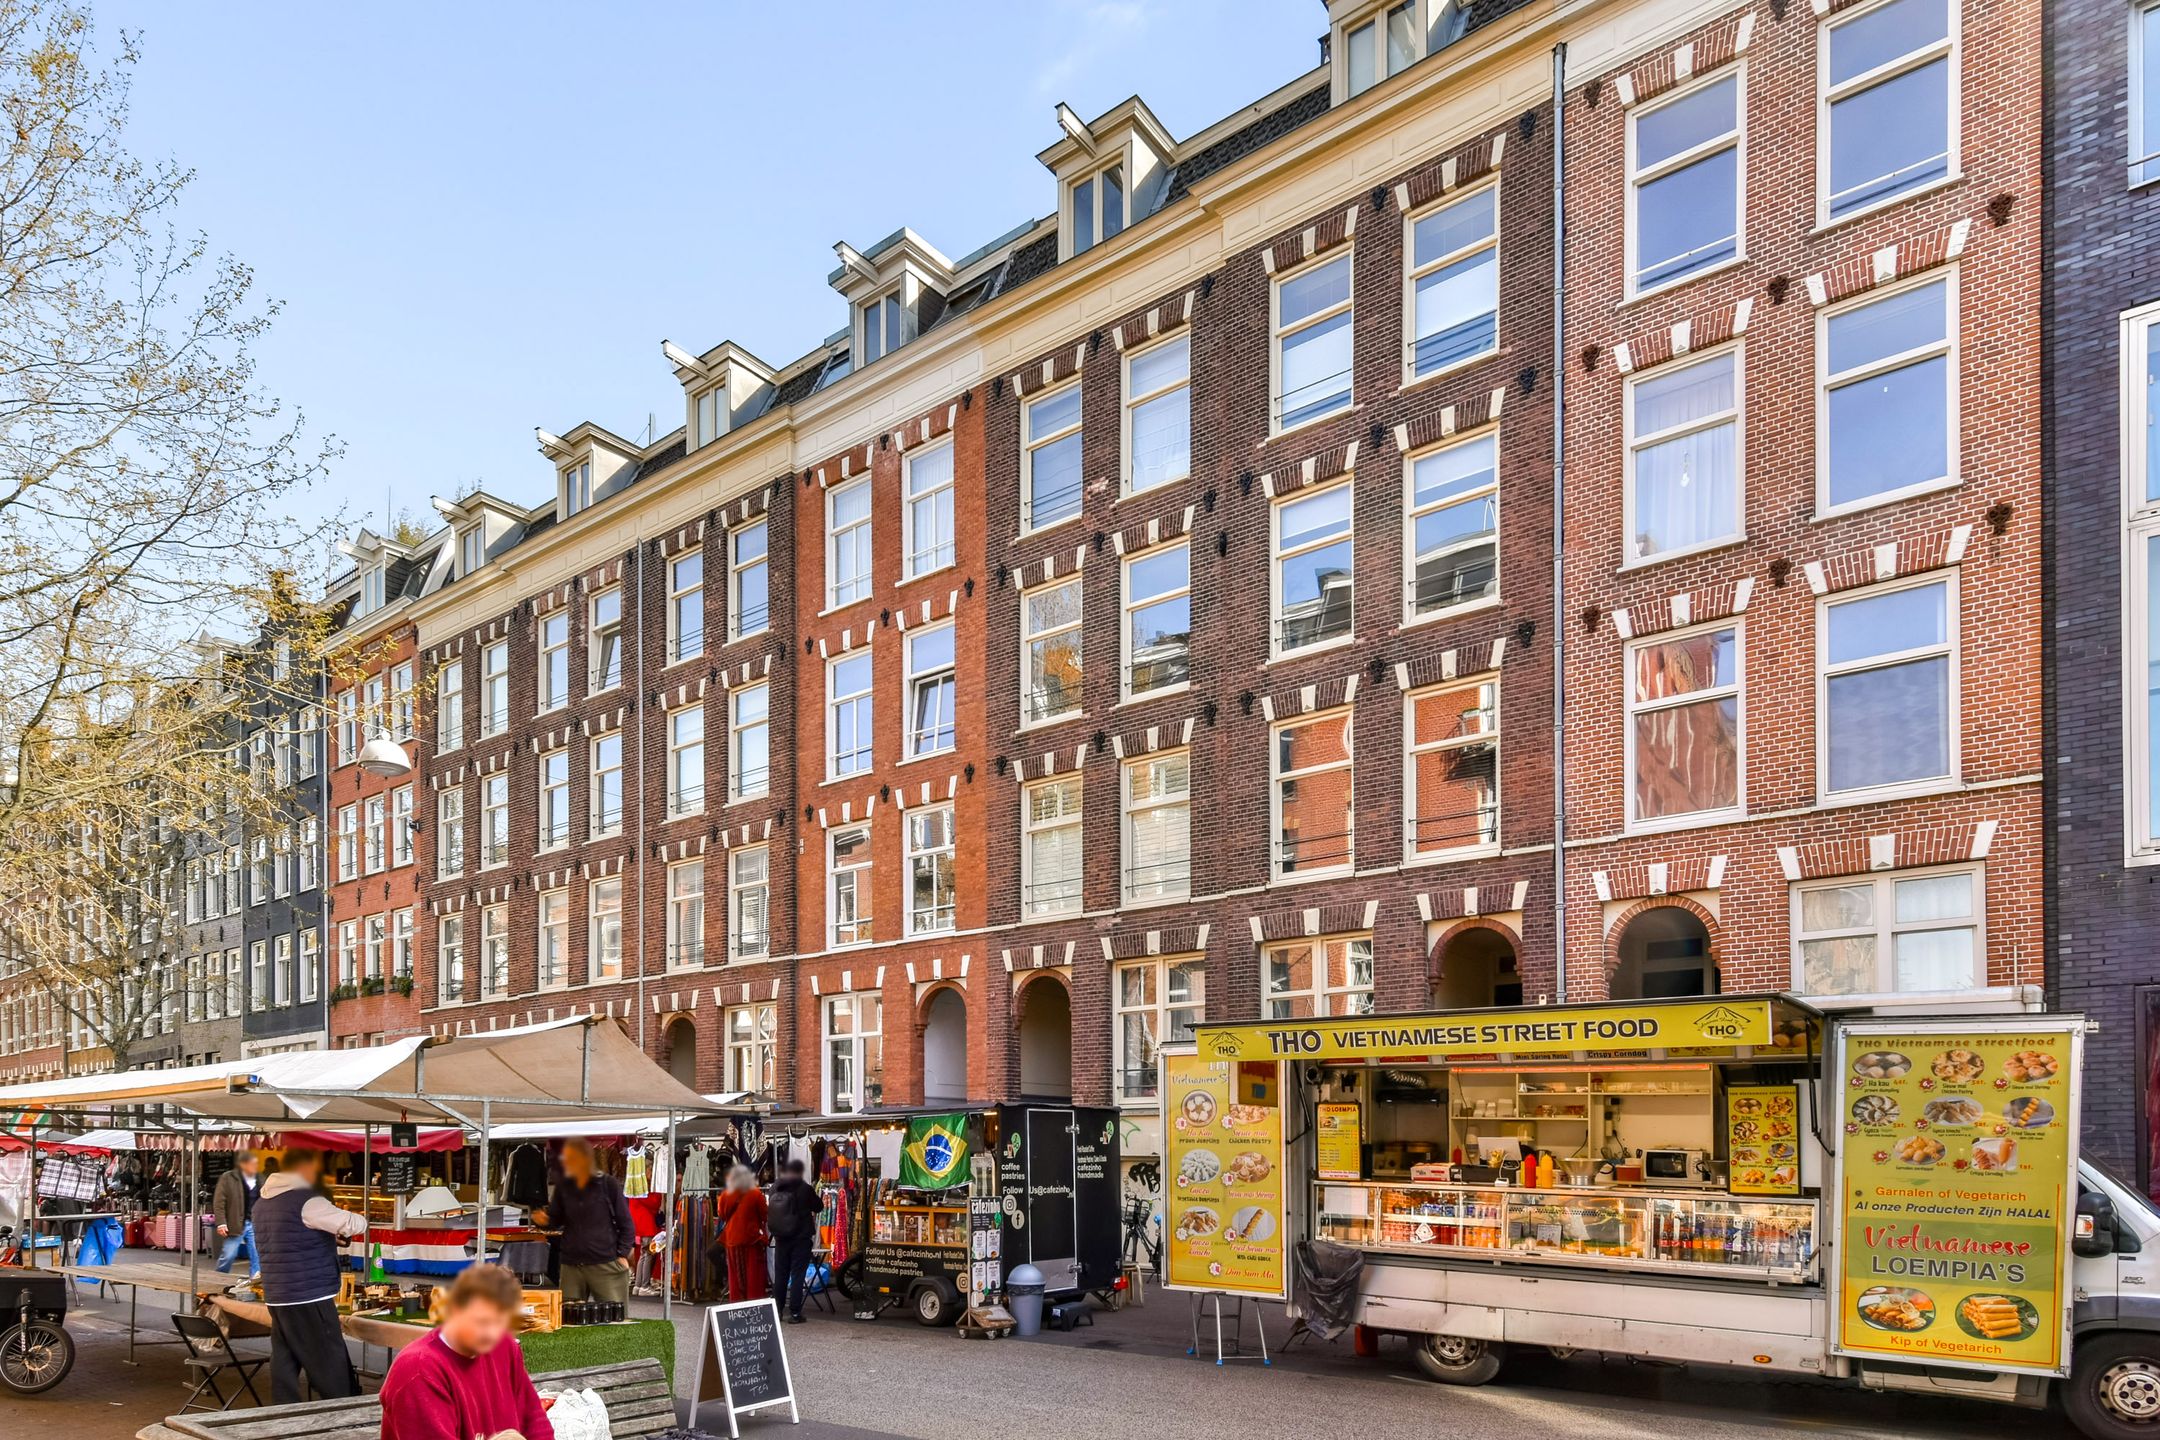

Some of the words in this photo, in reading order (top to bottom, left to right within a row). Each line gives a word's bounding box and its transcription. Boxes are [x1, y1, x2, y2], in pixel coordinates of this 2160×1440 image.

[1707, 1024, 1737, 1035] THO
[1267, 1029, 1323, 1055] THO
[1333, 1025, 1477, 1049] VIETNAMESE
[1481, 1021, 1578, 1044] STREET
[1583, 1018, 1659, 1041] FOOD
[1857, 1039, 1882, 1048] THO
[1887, 1038, 1970, 1048] Vietnamese
[1975, 1037, 2056, 1047] streetfood
[1217, 1045, 1236, 1055] THO
[1001, 1163, 1020, 1171] coffee
[1001, 1172, 1026, 1181] pastries
[1002, 1186, 1024, 1195] Follow
[1875, 1187, 1934, 1199] Garnalen
[1938, 1189, 1952, 1199] of
[1955, 1190, 2027, 1201] Vegetarich
[971, 1199, 1000, 1214] cafezinho
[1855, 1201, 1868, 1211] Al
[1871, 1204, 1902, 1212] onze
[1905, 1204, 1974, 1216] Producten
[1977, 1206, 2002, 1217] Zijn
[2006, 1208, 2051, 1219] HALAL
[1863, 1223, 2034, 1257] Vietnamese
[865, 1247, 886, 1256] Follow
[886, 1248, 895, 1256] Us
[868, 1257, 886, 1265] coffee
[890, 1259, 918, 1268] cafezinho
[869, 1265, 899, 1274] handmade
[900, 1268, 924, 1277] pastries
[1871, 1255, 2026, 1283] LOEMPIA'S
[728, 1306, 761, 1321] HARVEST
[749, 1323, 773, 1334] HONEY
[1890, 1335, 1912, 1348] Kip
[1915, 1338, 1929, 1348] of
[1932, 1339, 2002, 1354] Vegetarich
